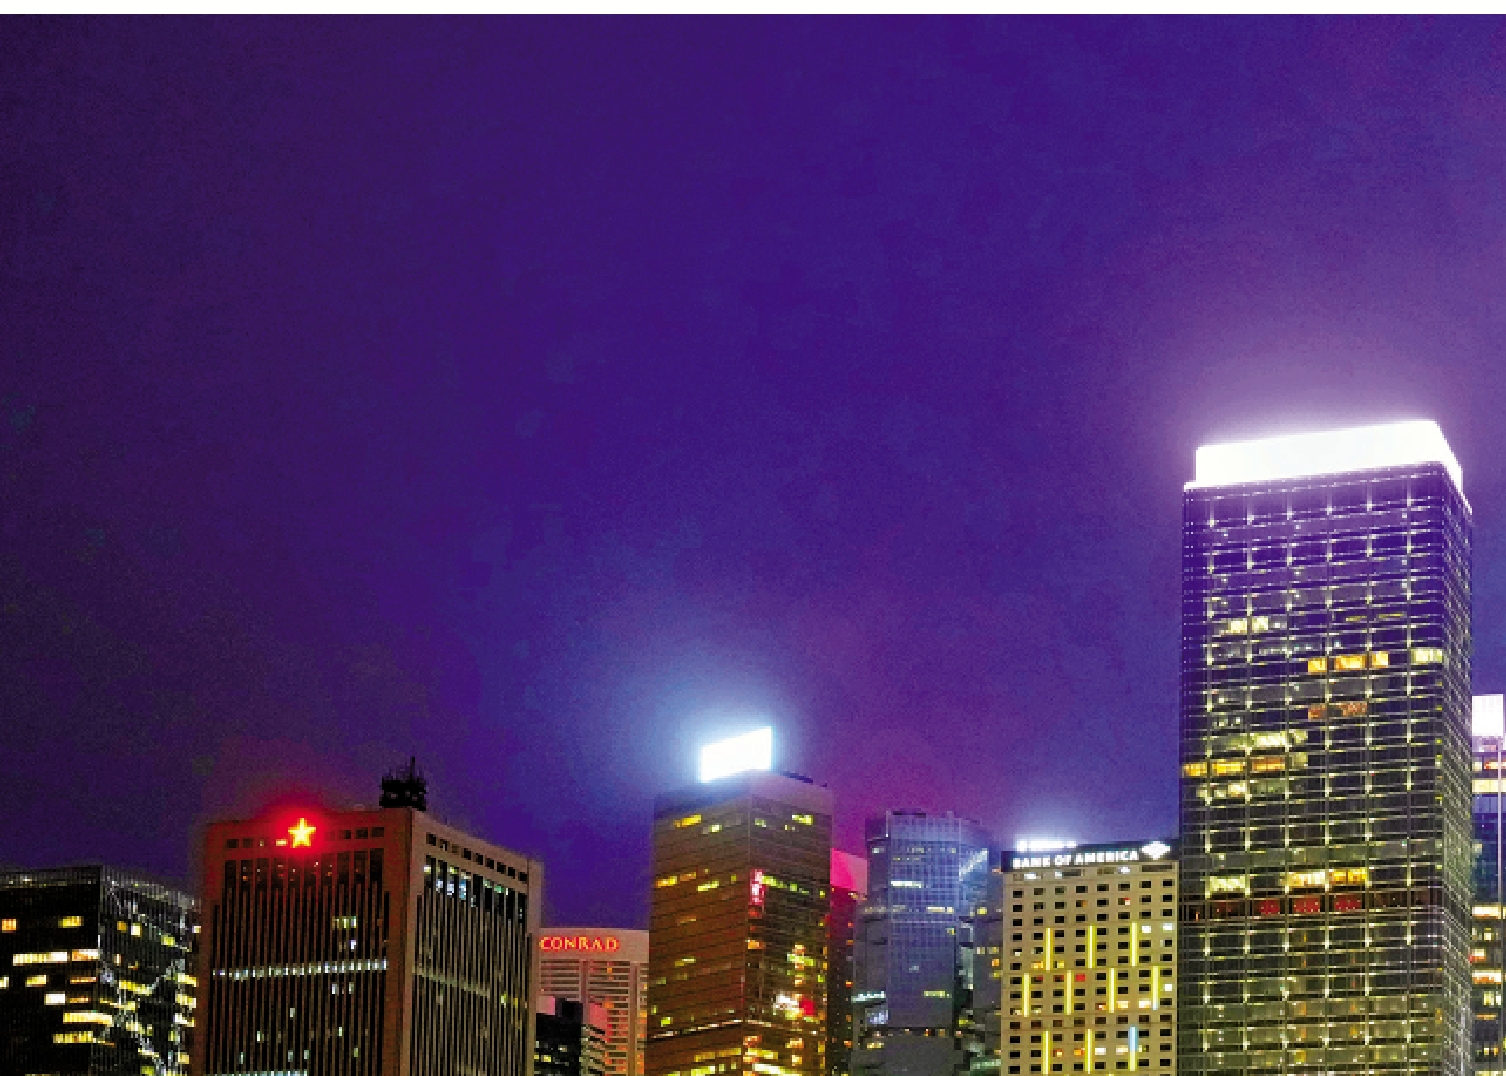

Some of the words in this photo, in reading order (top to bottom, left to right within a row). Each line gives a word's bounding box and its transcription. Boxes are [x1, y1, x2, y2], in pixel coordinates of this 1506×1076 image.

[1012, 857, 1051, 869] BANK
[1054, 854, 1072, 866] OF
[1075, 850, 1140, 866] AMERICA
[539, 936, 620, 951] CONRAD
